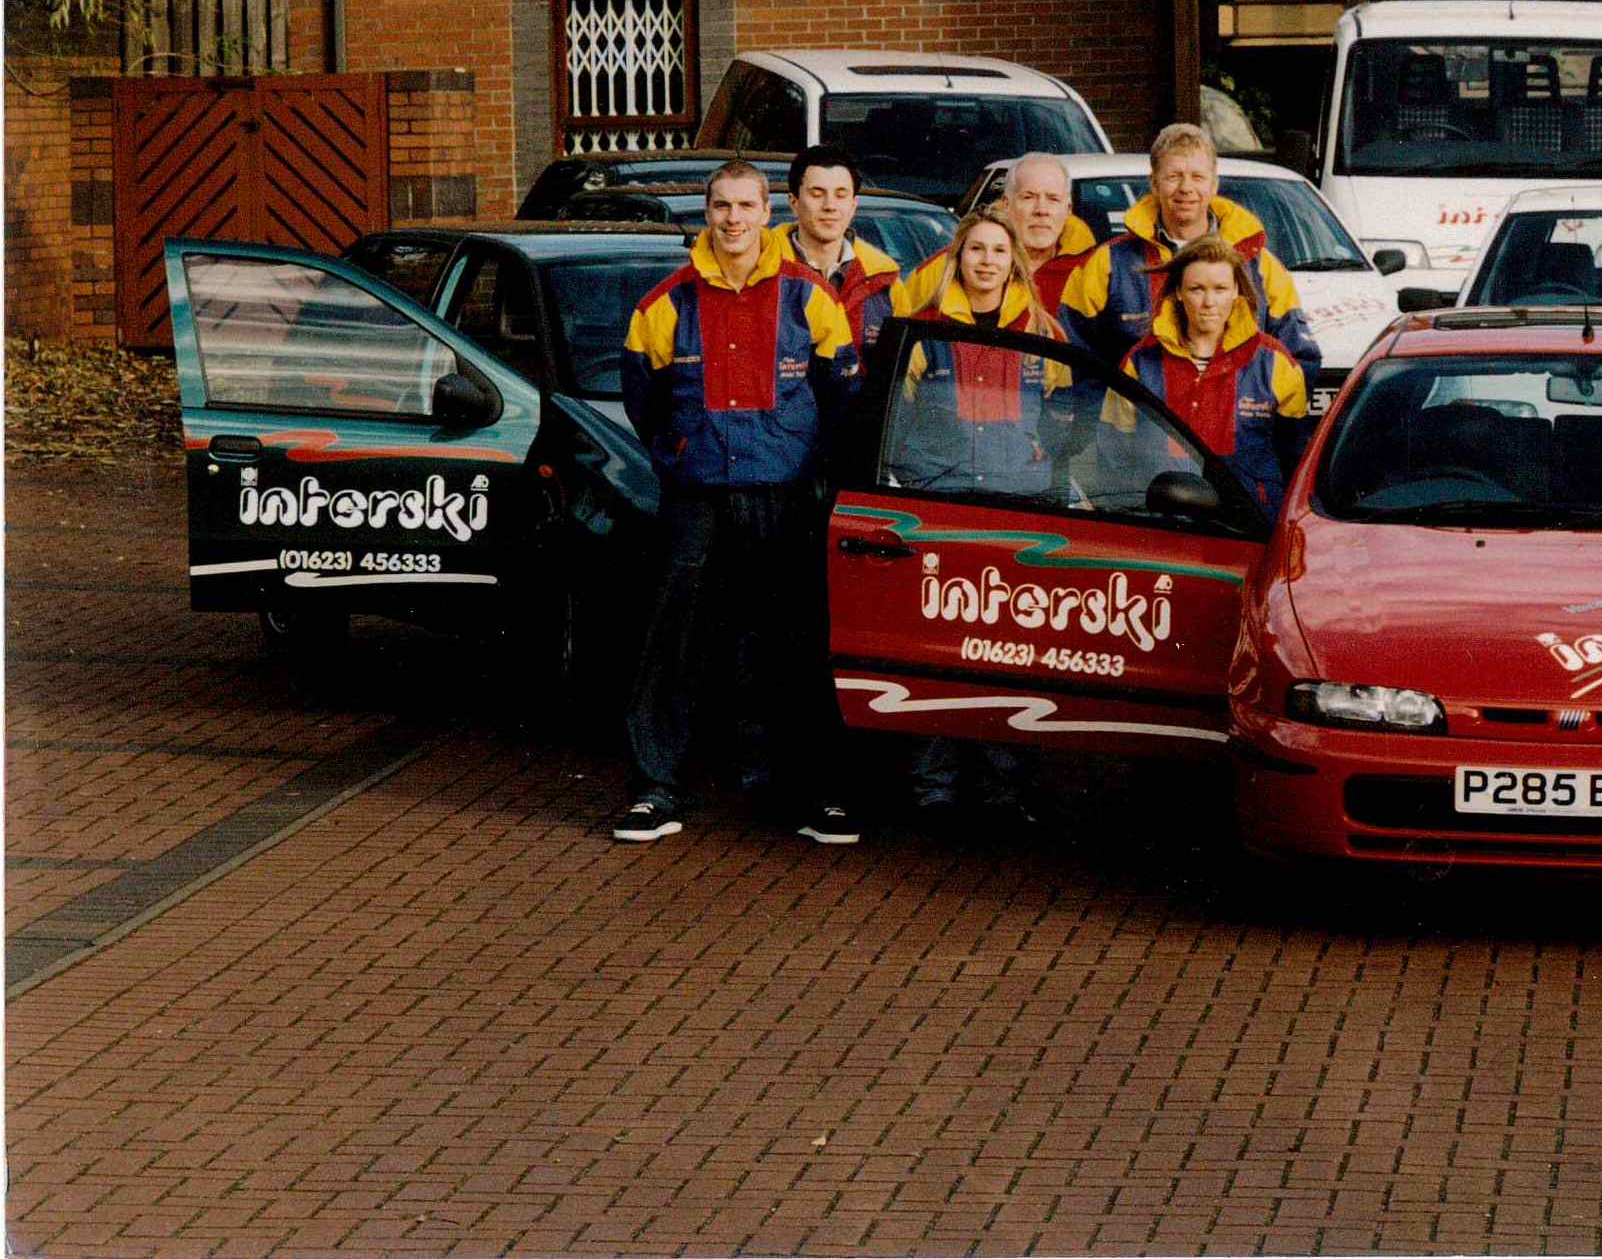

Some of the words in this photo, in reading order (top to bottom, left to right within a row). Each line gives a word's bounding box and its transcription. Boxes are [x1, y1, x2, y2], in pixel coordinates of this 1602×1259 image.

[239, 467, 489, 542] interski
[279, 549, 353, 571] (01623)
[359, 553, 441, 572] 456333
[921, 553, 1172, 652] interski
[961, 636, 1035, 668] (01623)
[1040, 647, 1126, 678] 456333
[1463, 769, 1577, 807] P285
